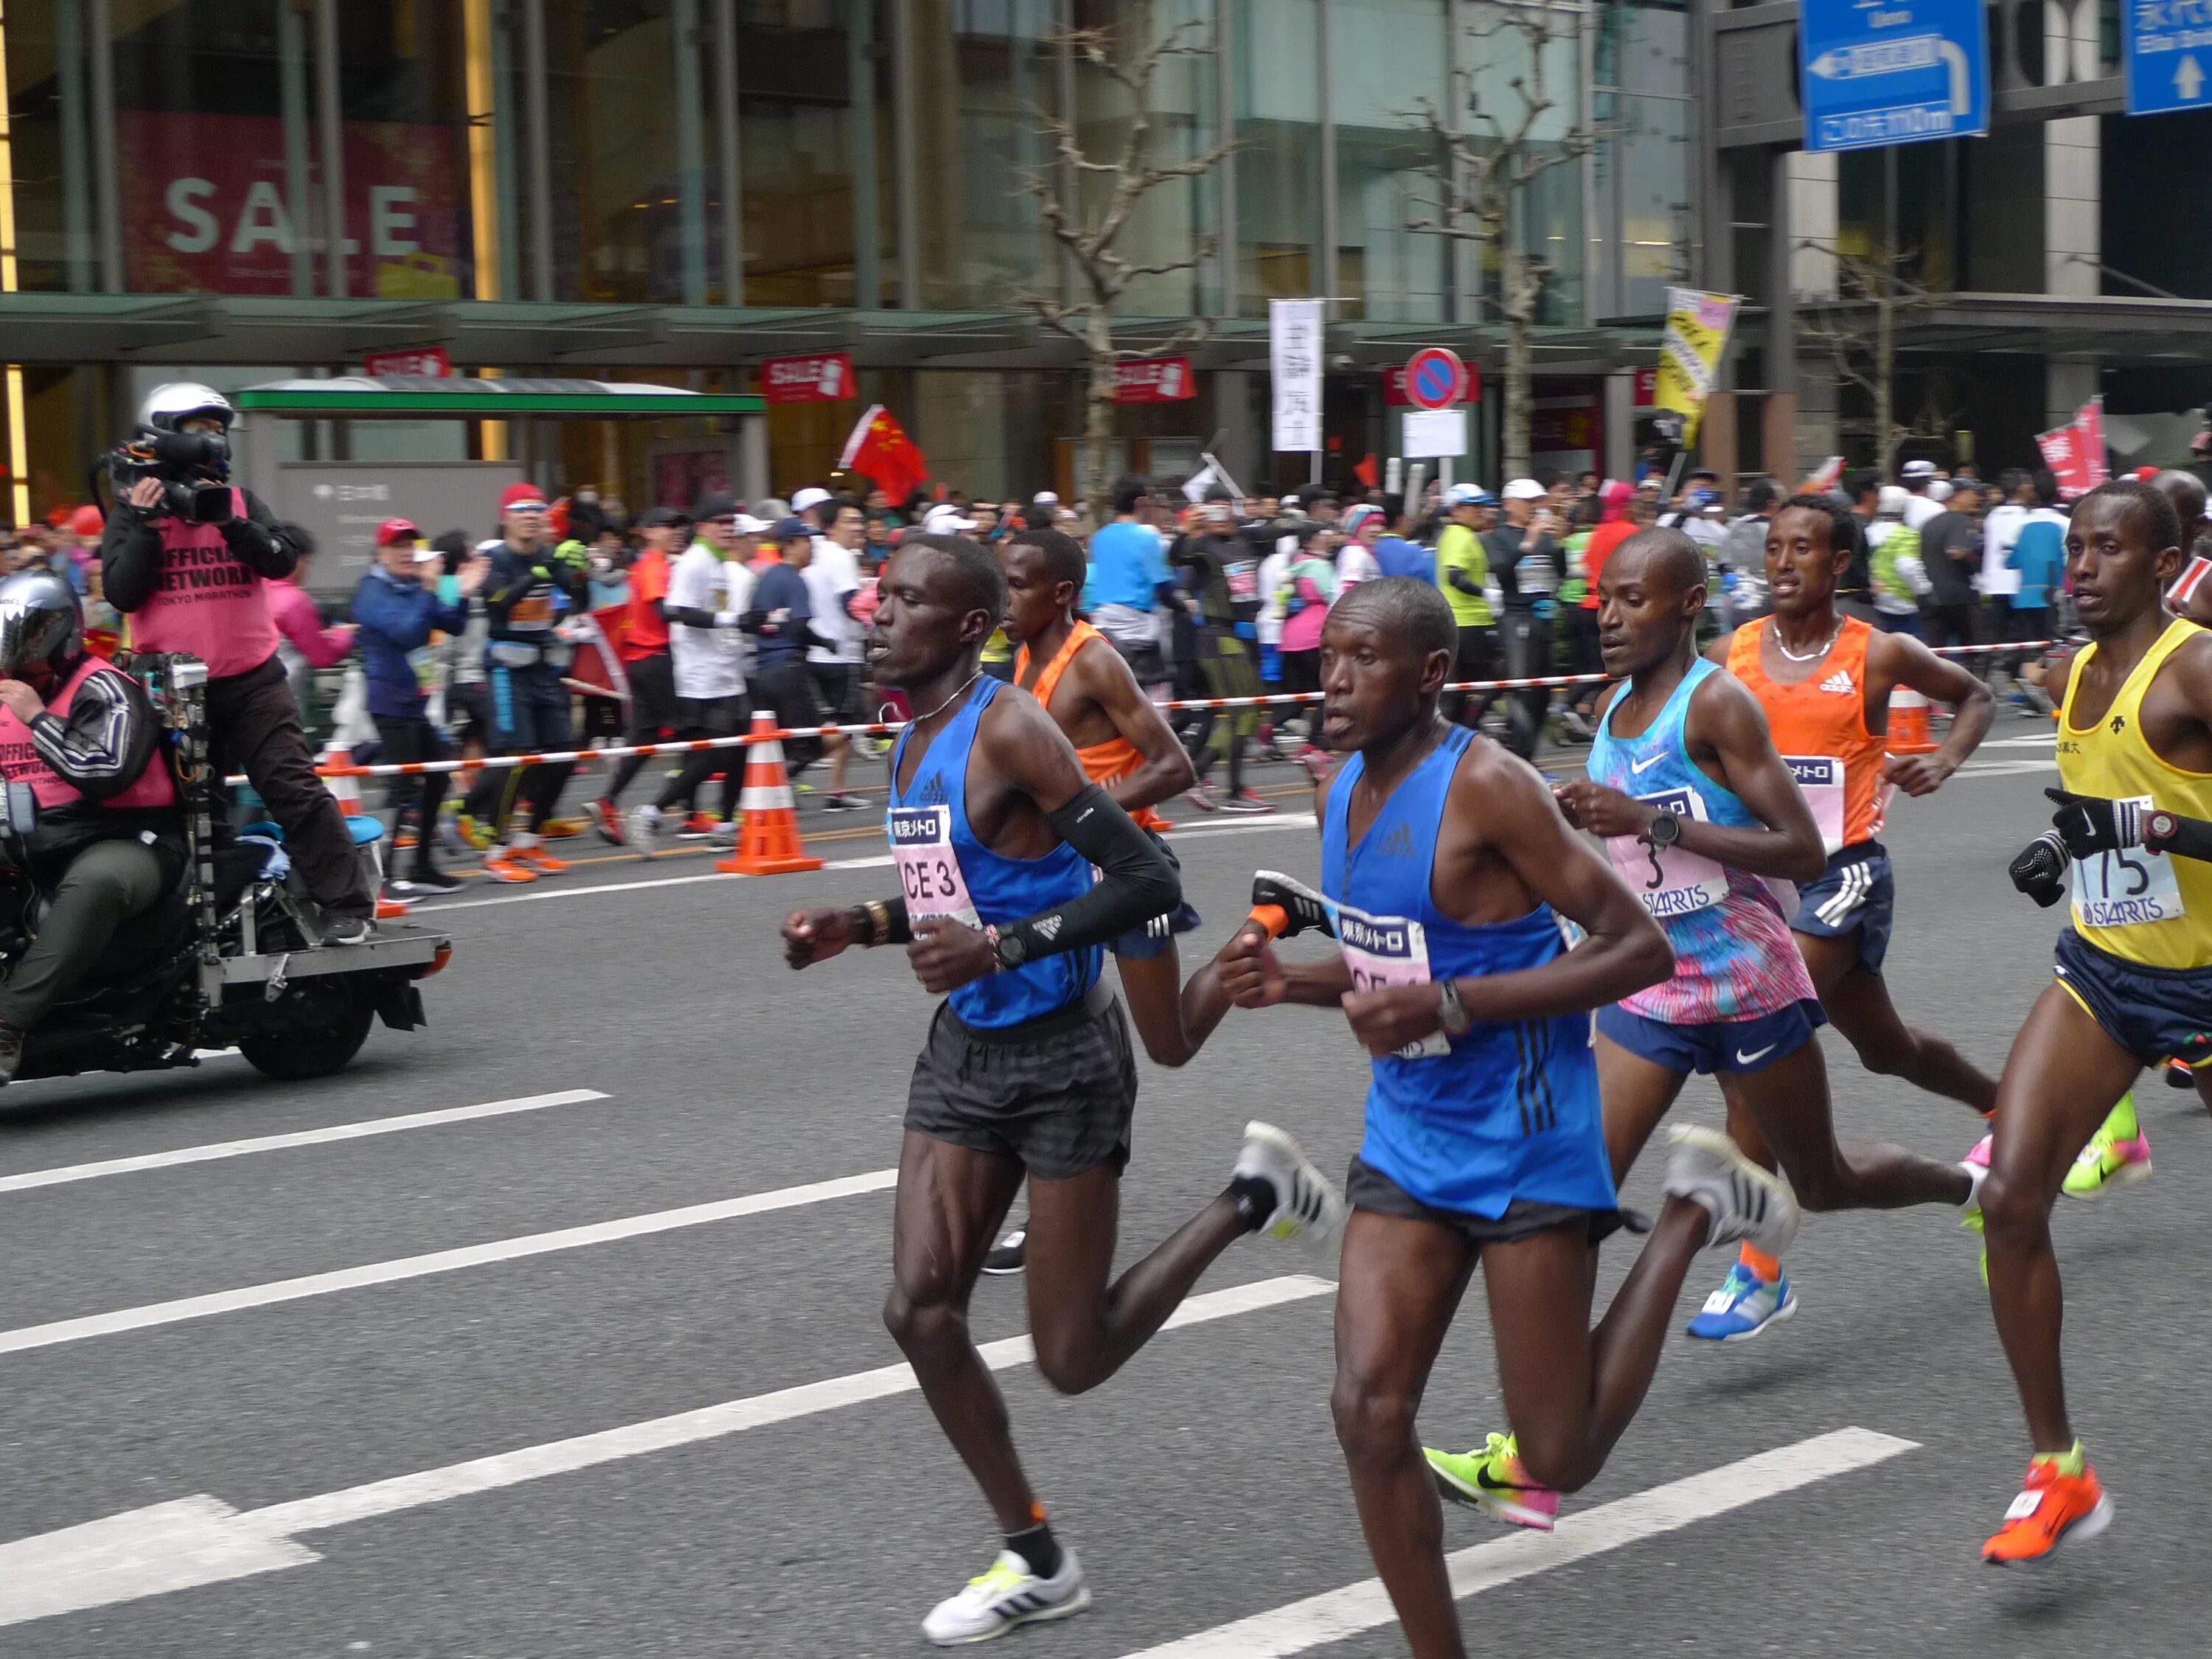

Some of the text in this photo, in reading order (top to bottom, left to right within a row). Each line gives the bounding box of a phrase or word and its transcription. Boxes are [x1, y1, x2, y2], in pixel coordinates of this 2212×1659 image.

[165, 177, 420, 256] SALE
[195, 591, 251, 601] MARATHON
[894, 818, 936, 838] 東京メトロ
[1636, 834, 1663, 889] 3
[936, 860, 956, 897] 3
[2093, 896, 2164, 925] STARTS
